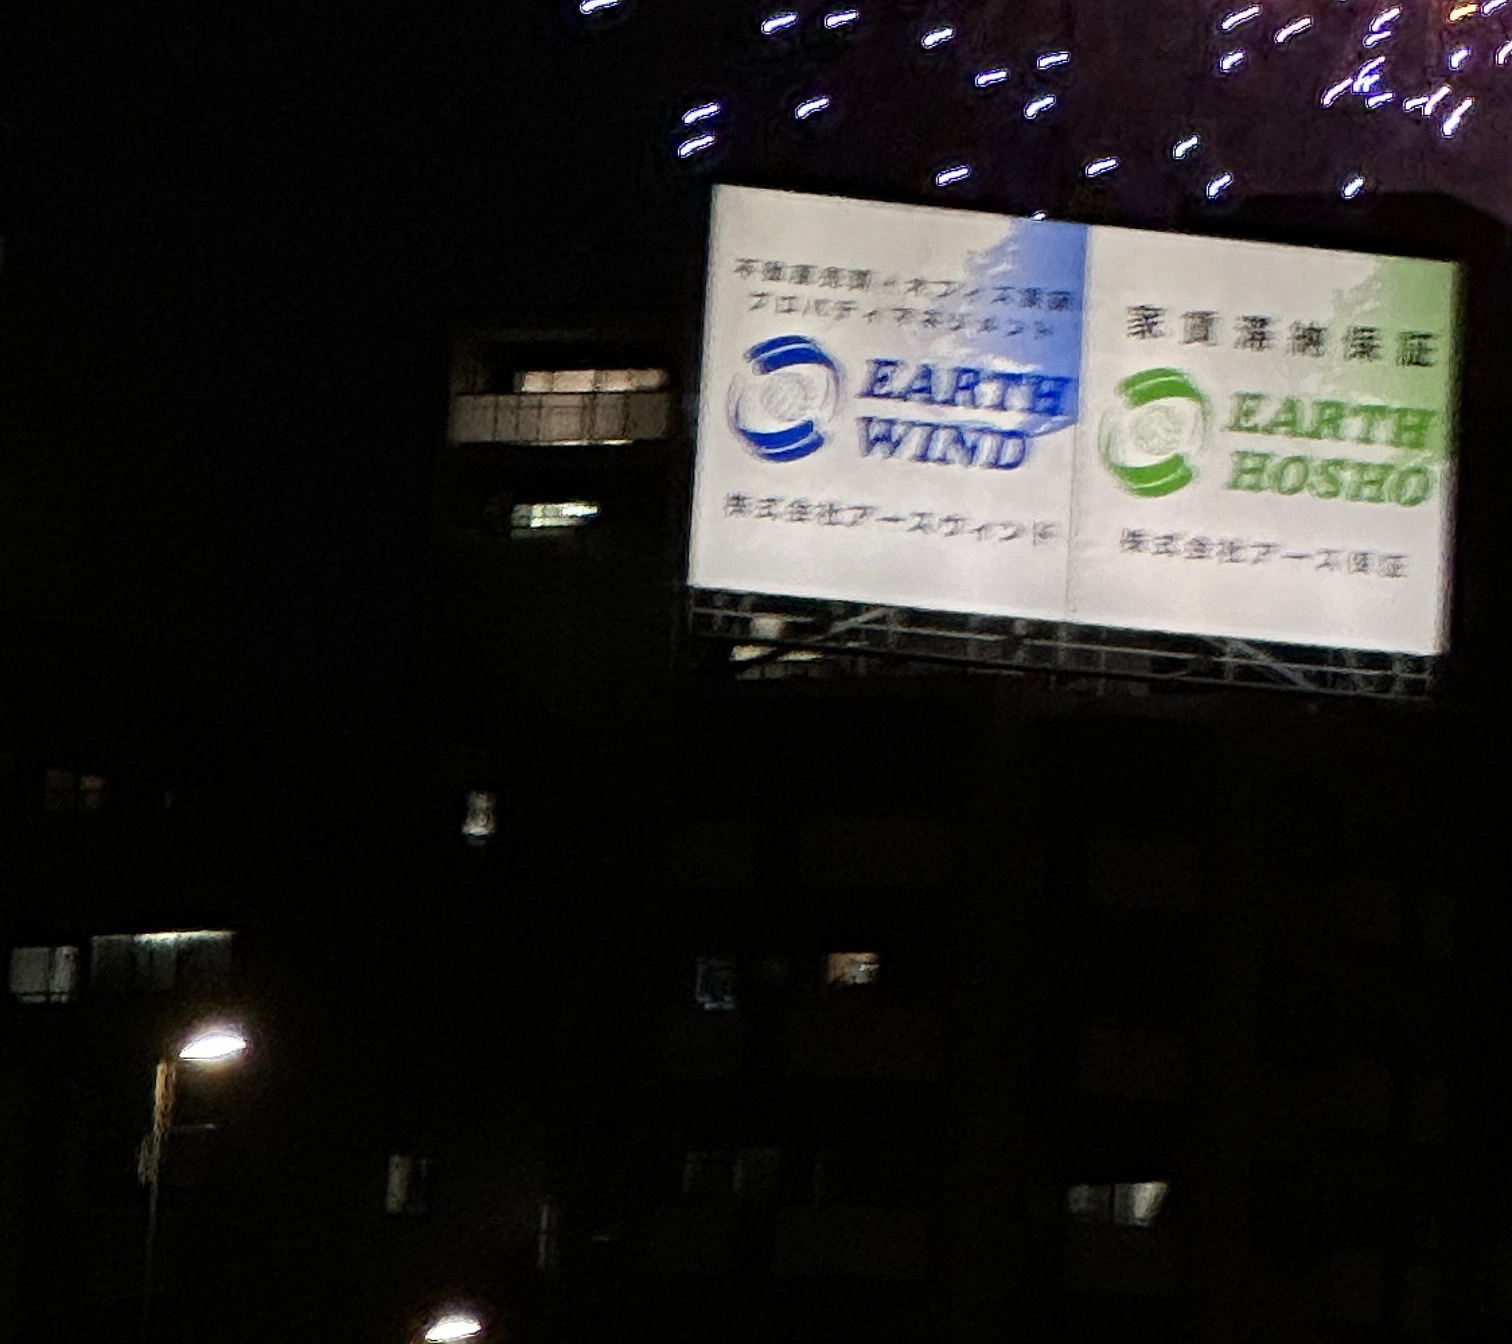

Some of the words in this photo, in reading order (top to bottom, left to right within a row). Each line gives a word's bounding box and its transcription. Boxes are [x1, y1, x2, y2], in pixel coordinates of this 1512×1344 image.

[1126, 303, 1440, 369] 家賃滞納保証
[857, 358, 1074, 418] EARTH
[858, 415, 1029, 470] WIND
[1225, 392, 1441, 450] EARTH
[1225, 450, 1432, 508] HOSHO
